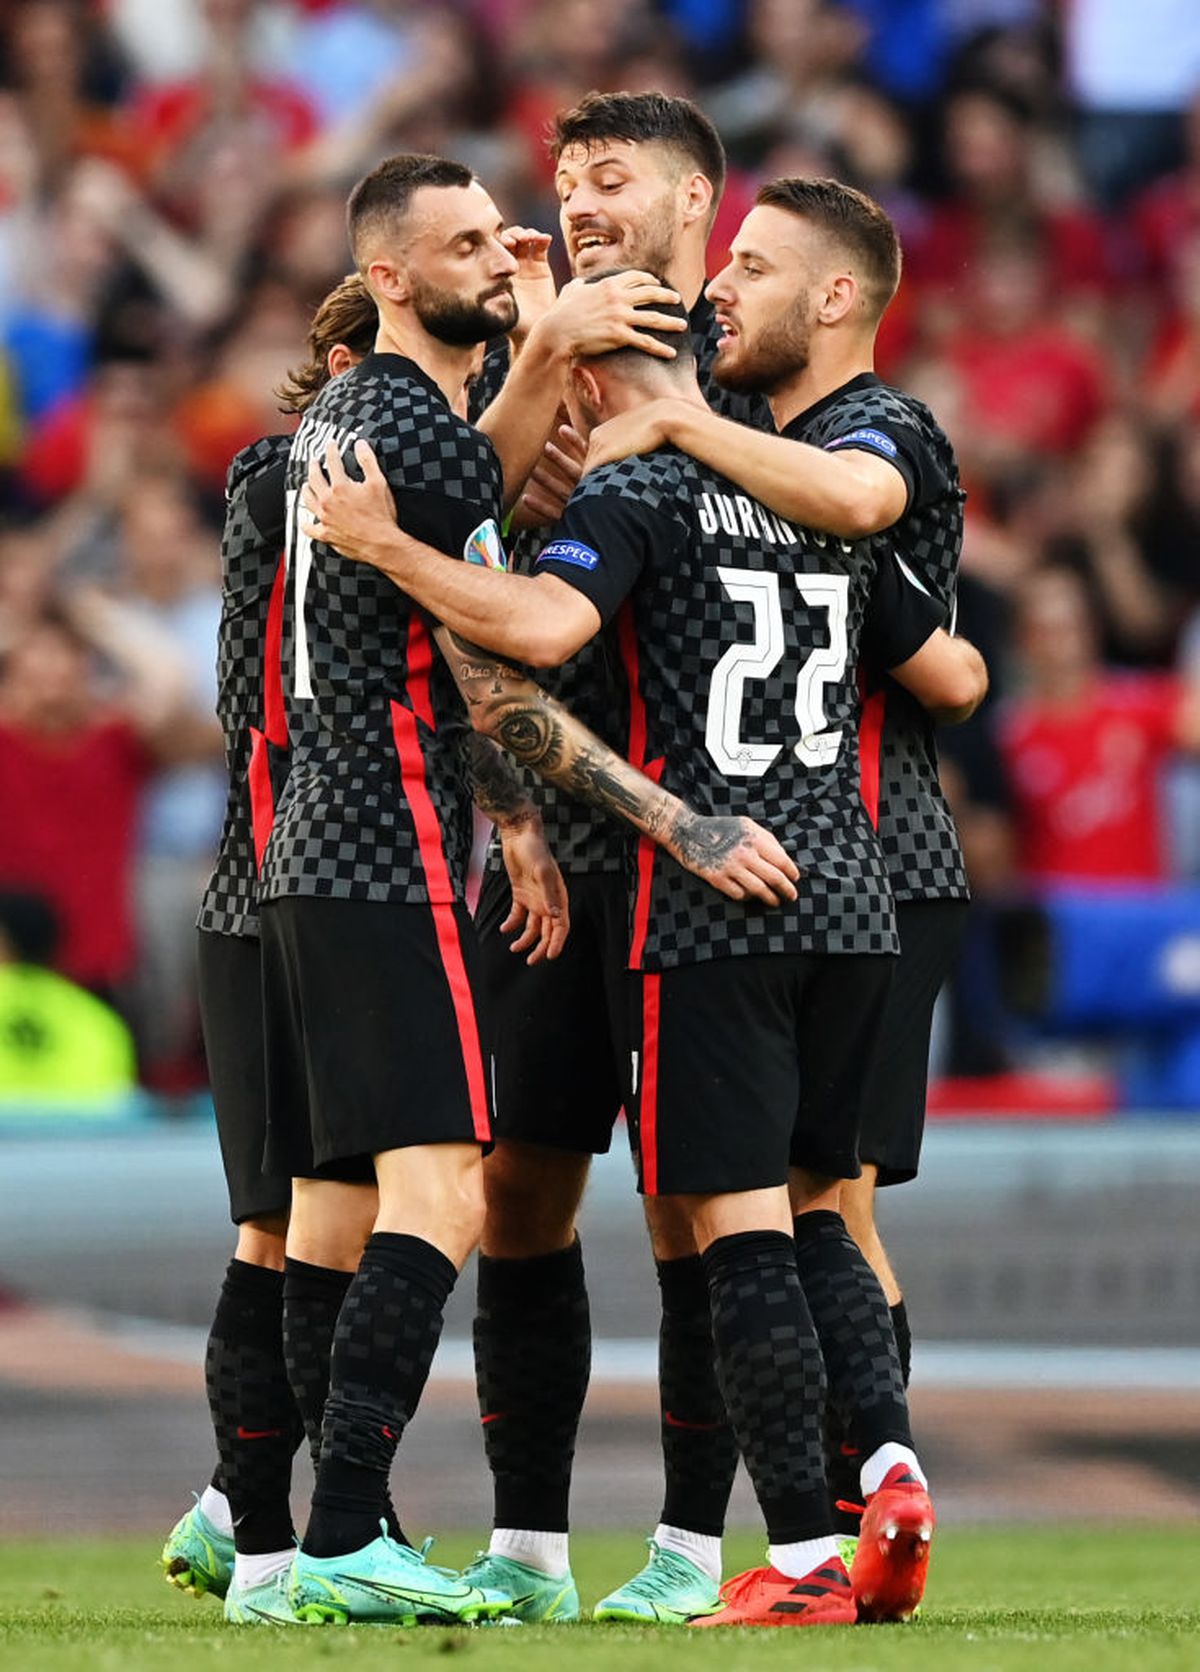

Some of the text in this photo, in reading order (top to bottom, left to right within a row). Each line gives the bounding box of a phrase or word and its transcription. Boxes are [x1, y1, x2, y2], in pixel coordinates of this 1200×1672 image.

[698, 492, 852, 554] JURAN
[546, 544, 597, 565] RESPECT
[705, 566, 850, 777] 22
